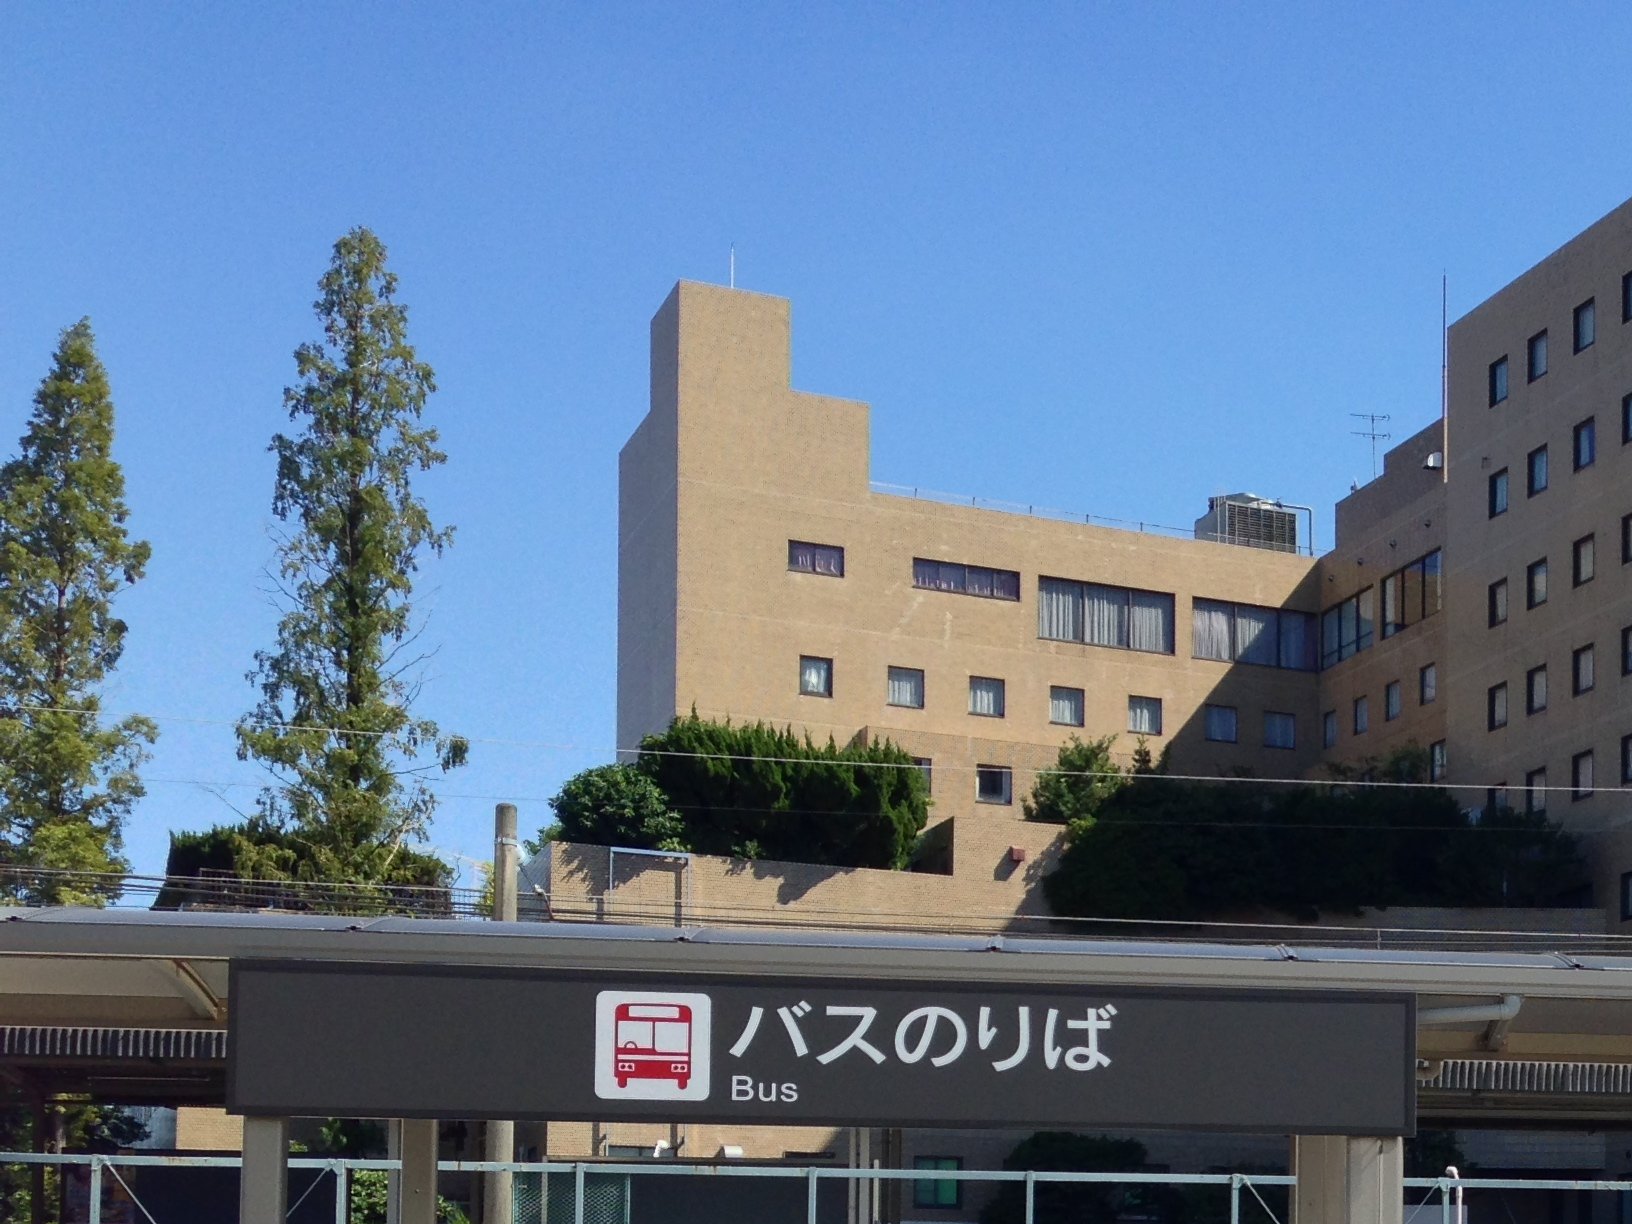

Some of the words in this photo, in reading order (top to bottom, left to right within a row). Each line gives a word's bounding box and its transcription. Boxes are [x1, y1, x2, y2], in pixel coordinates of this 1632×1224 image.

[729, 1000, 1117, 1072] バスのりば
[730, 1074, 799, 1104] Bus
